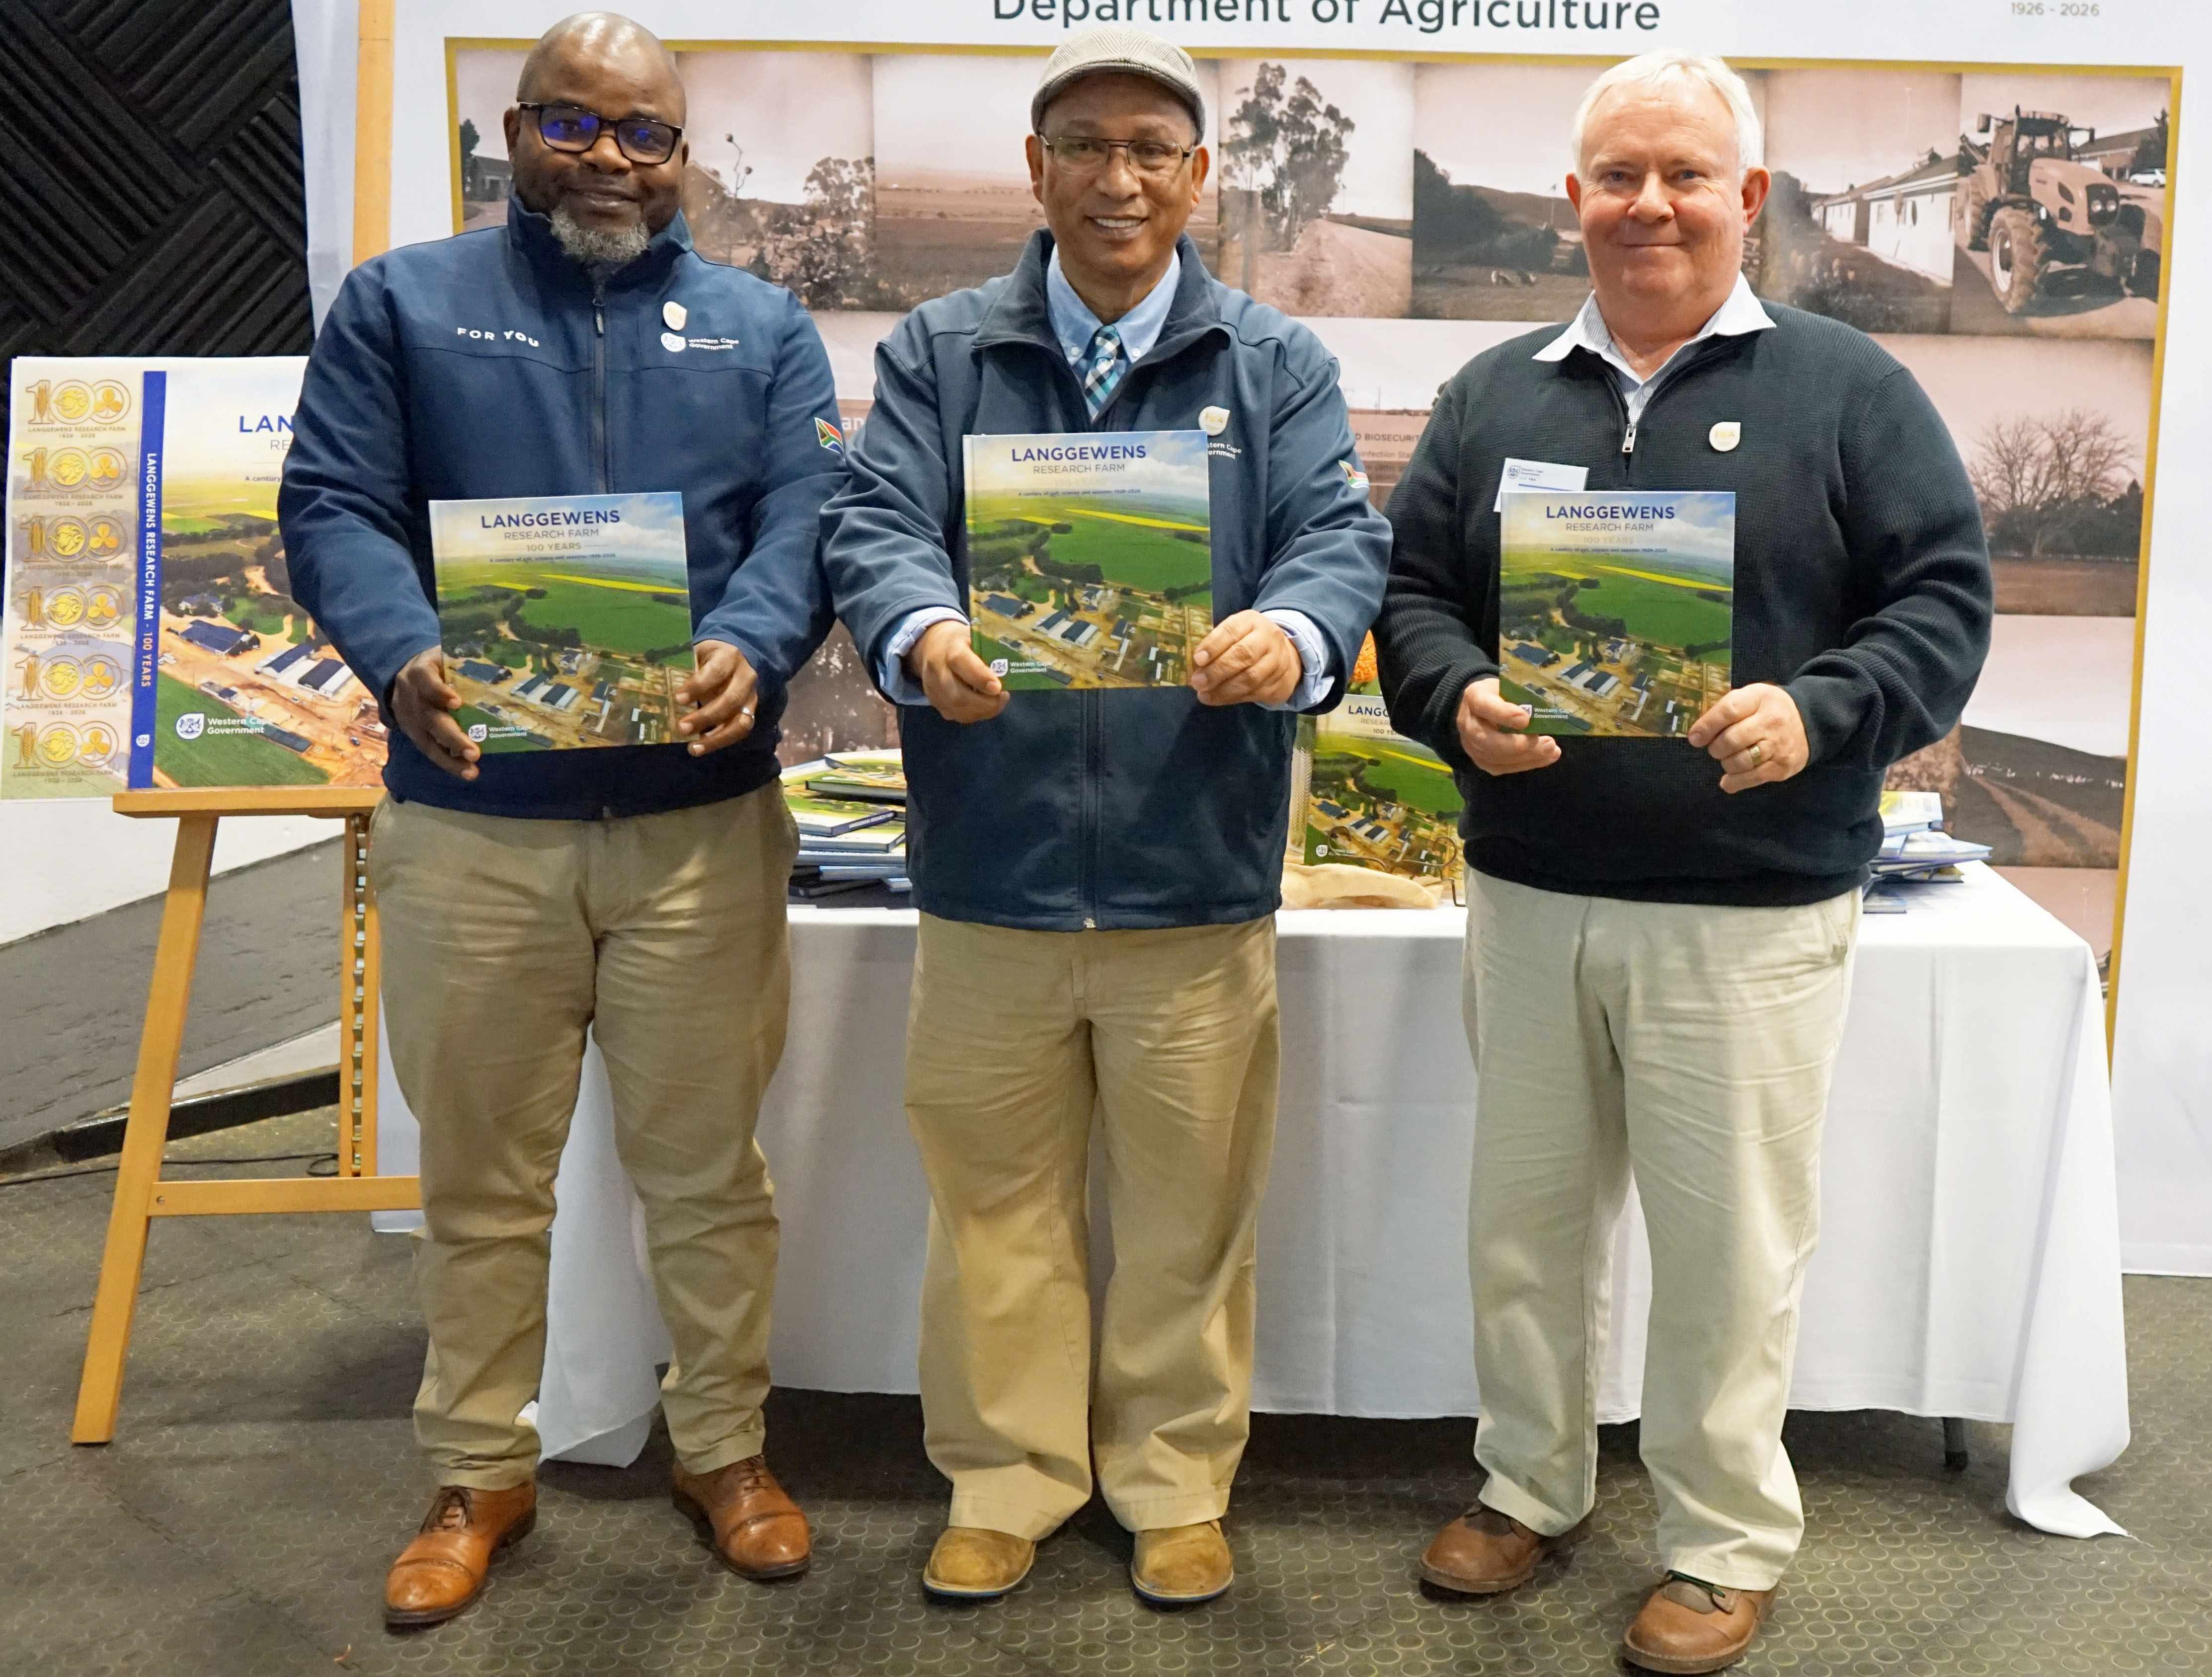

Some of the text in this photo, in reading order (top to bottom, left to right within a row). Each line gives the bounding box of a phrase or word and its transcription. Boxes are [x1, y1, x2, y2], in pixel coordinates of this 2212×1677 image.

[994, 0, 1660, 33] Department of Agriculture
[2011, 2, 2045, 16] 1926
[2059, 2, 2100, 17] 2026
[457, 327, 539, 348] FOR YOU
[1364, 433, 1420, 442] BIOSECURIT
[1011, 445, 1147, 462] LANGGEWENS
[1208, 450, 1236, 459] ernment
[1033, 463, 1125, 474] RESEARCH FARM
[146, 453, 157, 528] LANGGEWENS
[480, 509, 620, 529] LANGGEWENS
[1546, 506, 1675, 519] LANGGEWENS
[504, 529, 600, 541] RESEARCH FARM
[1566, 523, 1654, 532] RESEARCH FARM
[548, 542, 581, 551] YEARS
[144, 532, 156, 587] RESEARCH
[144, 590, 155, 620] FARM
[143, 632, 154, 650] 100
[141, 652, 153, 688] YEARS
